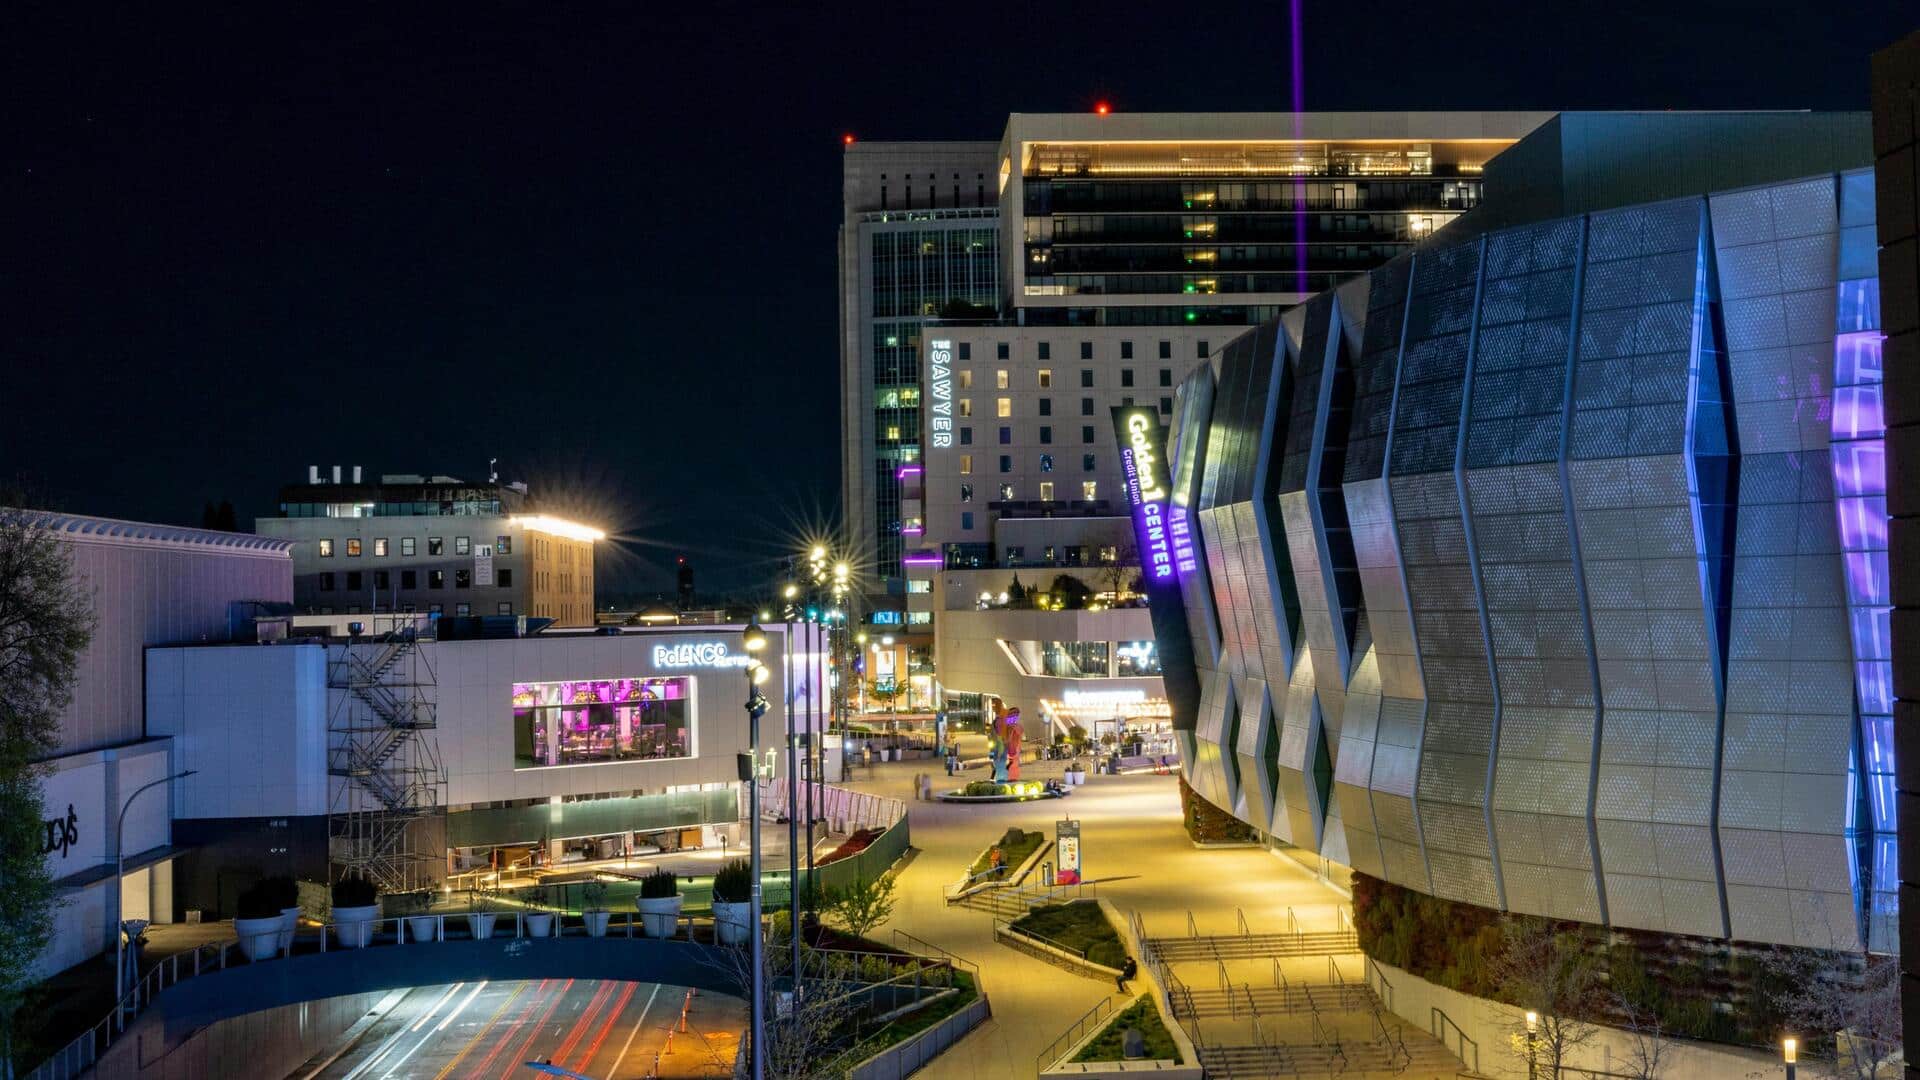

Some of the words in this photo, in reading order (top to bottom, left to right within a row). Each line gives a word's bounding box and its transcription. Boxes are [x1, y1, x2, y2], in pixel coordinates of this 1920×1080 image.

[933, 351, 952, 448] SAWYER
[1123, 449, 1137, 478] Credit
[1128, 414, 1155, 490] Golden
[1129, 479, 1140, 505] Union
[1142, 487, 1165, 502] 1
[1144, 503, 1171, 578] CENTER
